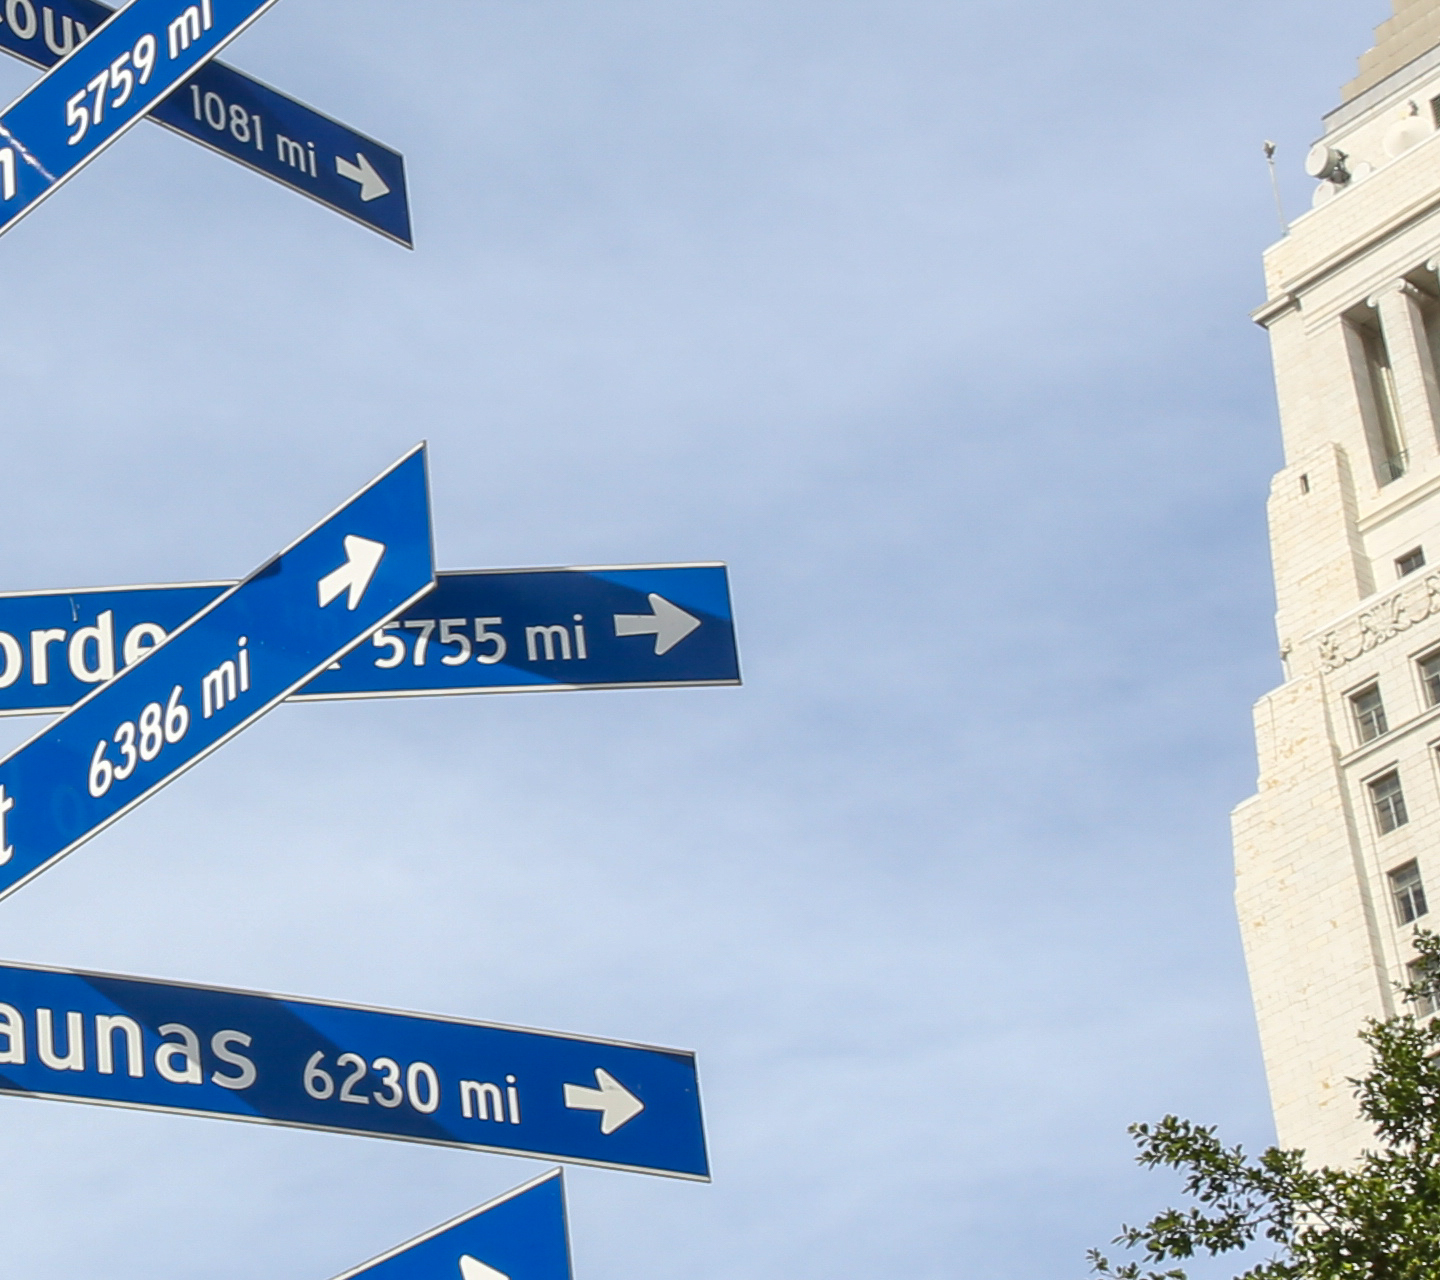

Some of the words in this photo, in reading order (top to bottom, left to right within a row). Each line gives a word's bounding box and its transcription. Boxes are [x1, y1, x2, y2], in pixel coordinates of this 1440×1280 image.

[65, 34, 156, 146] 5759
[190, 84, 263, 152] 1081
[277, 132, 318, 179] mi
[372, 617, 507, 669] 5755
[525, 613, 588, 662] mi
[87, 684, 189, 800] 6386
[201, 635, 251, 721] mi
[301, 1050, 441, 1116] 6230
[459, 1073, 521, 1126] mi
